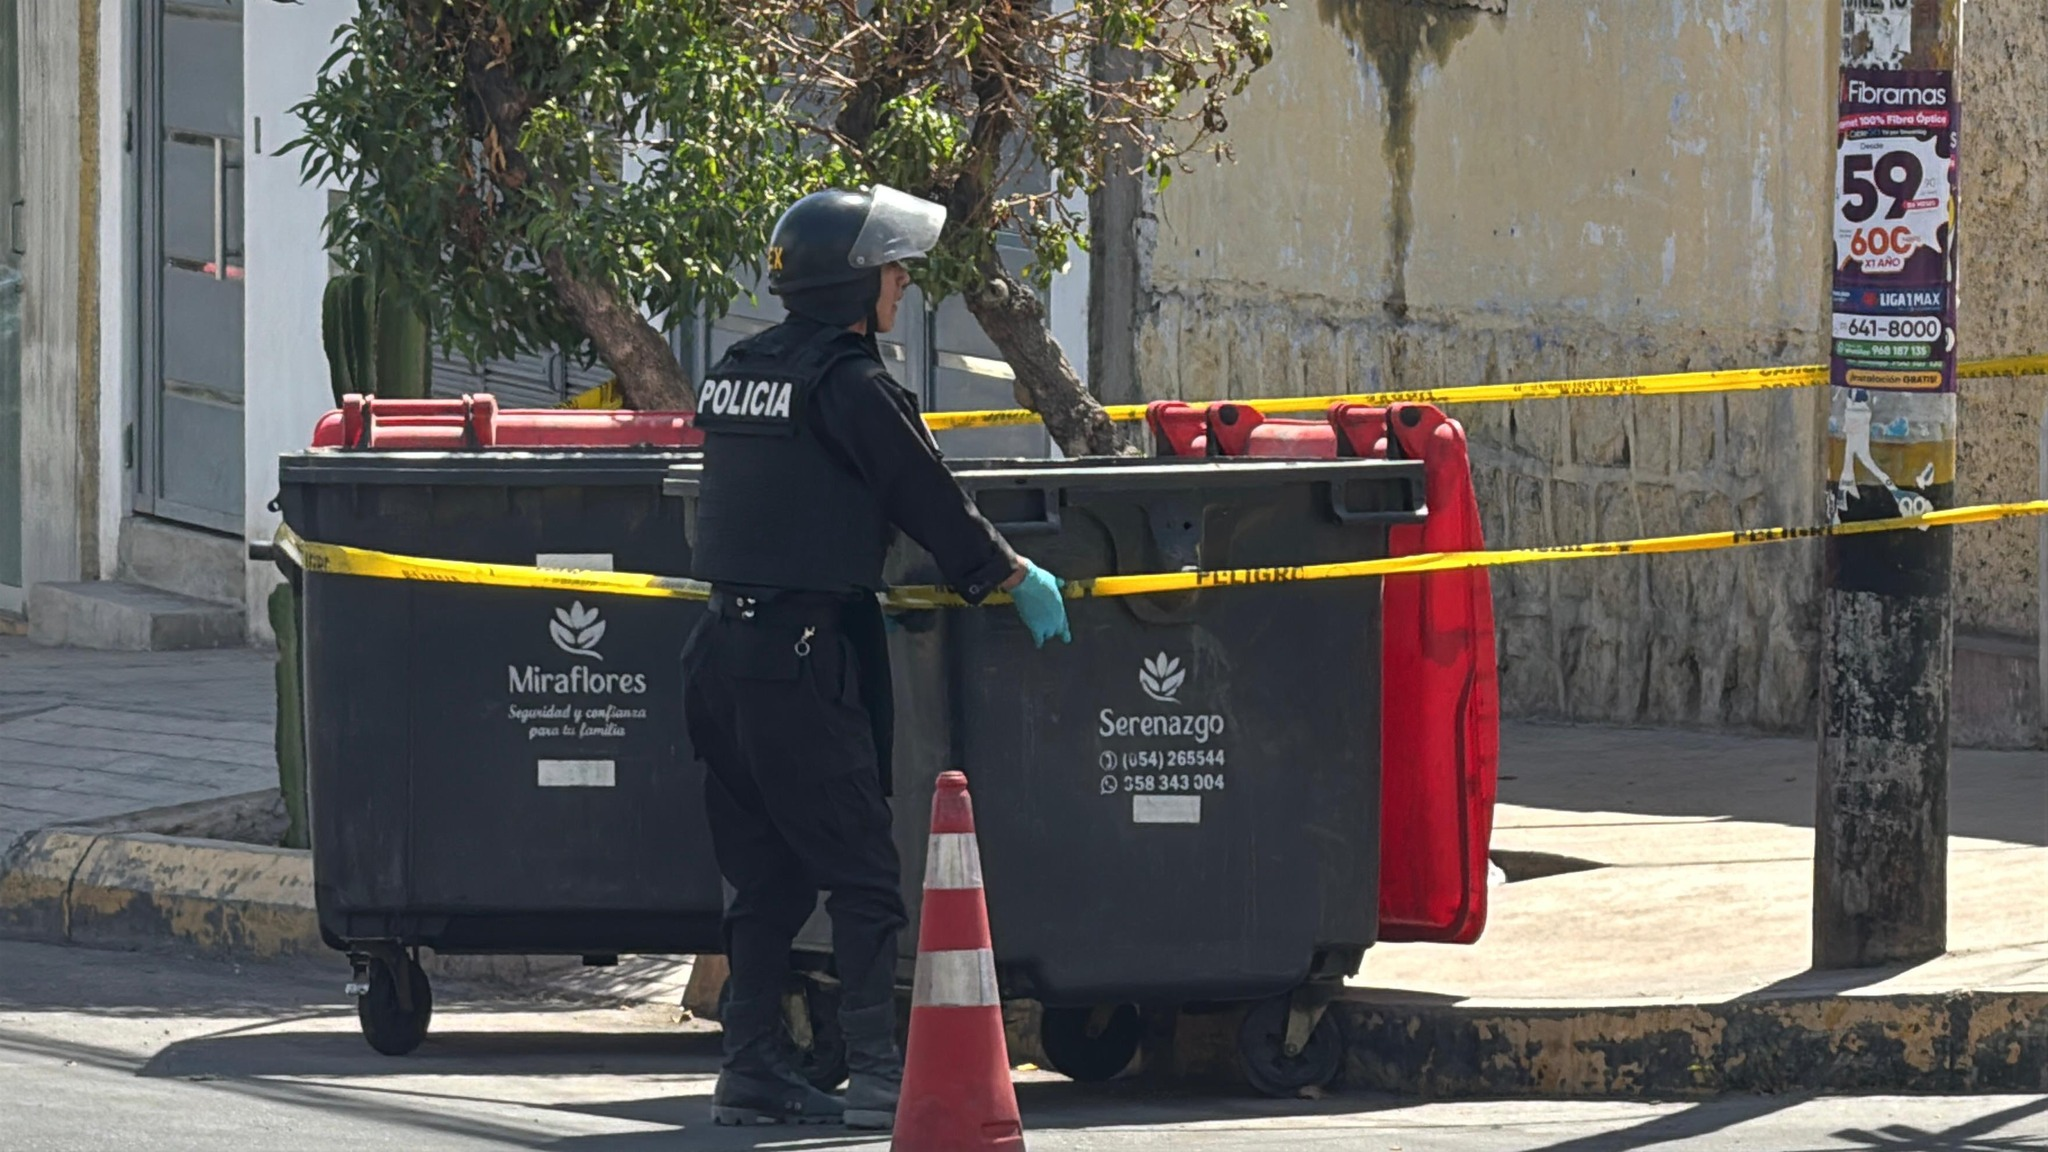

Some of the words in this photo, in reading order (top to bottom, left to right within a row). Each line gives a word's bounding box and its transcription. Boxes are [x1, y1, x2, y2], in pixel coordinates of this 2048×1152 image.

[1848, 80, 1947, 105] Fibramas
[1859, 115, 1885, 126] 100%
[1886, 114, 1914, 125] Fibra
[1860, 142, 1884, 150] Desde
[1841, 150, 1924, 223] 59
[1878, 256, 1900, 267] AÑO
[1848, 318, 1938, 338] 641-8000
[697, 380, 793, 418] POLICIA
[508, 664, 647, 694] Miraflores
[508, 703, 572, 723] Seguridad
[574, 709, 583, 723] y
[585, 704, 647, 722] confianza
[528, 725, 559, 740] para
[578, 722, 626, 738] familia
[1099, 708, 1224, 744] Serenazgo
[1167, 749, 1225, 767] 265544
[1158, 775, 1190, 791] 343
